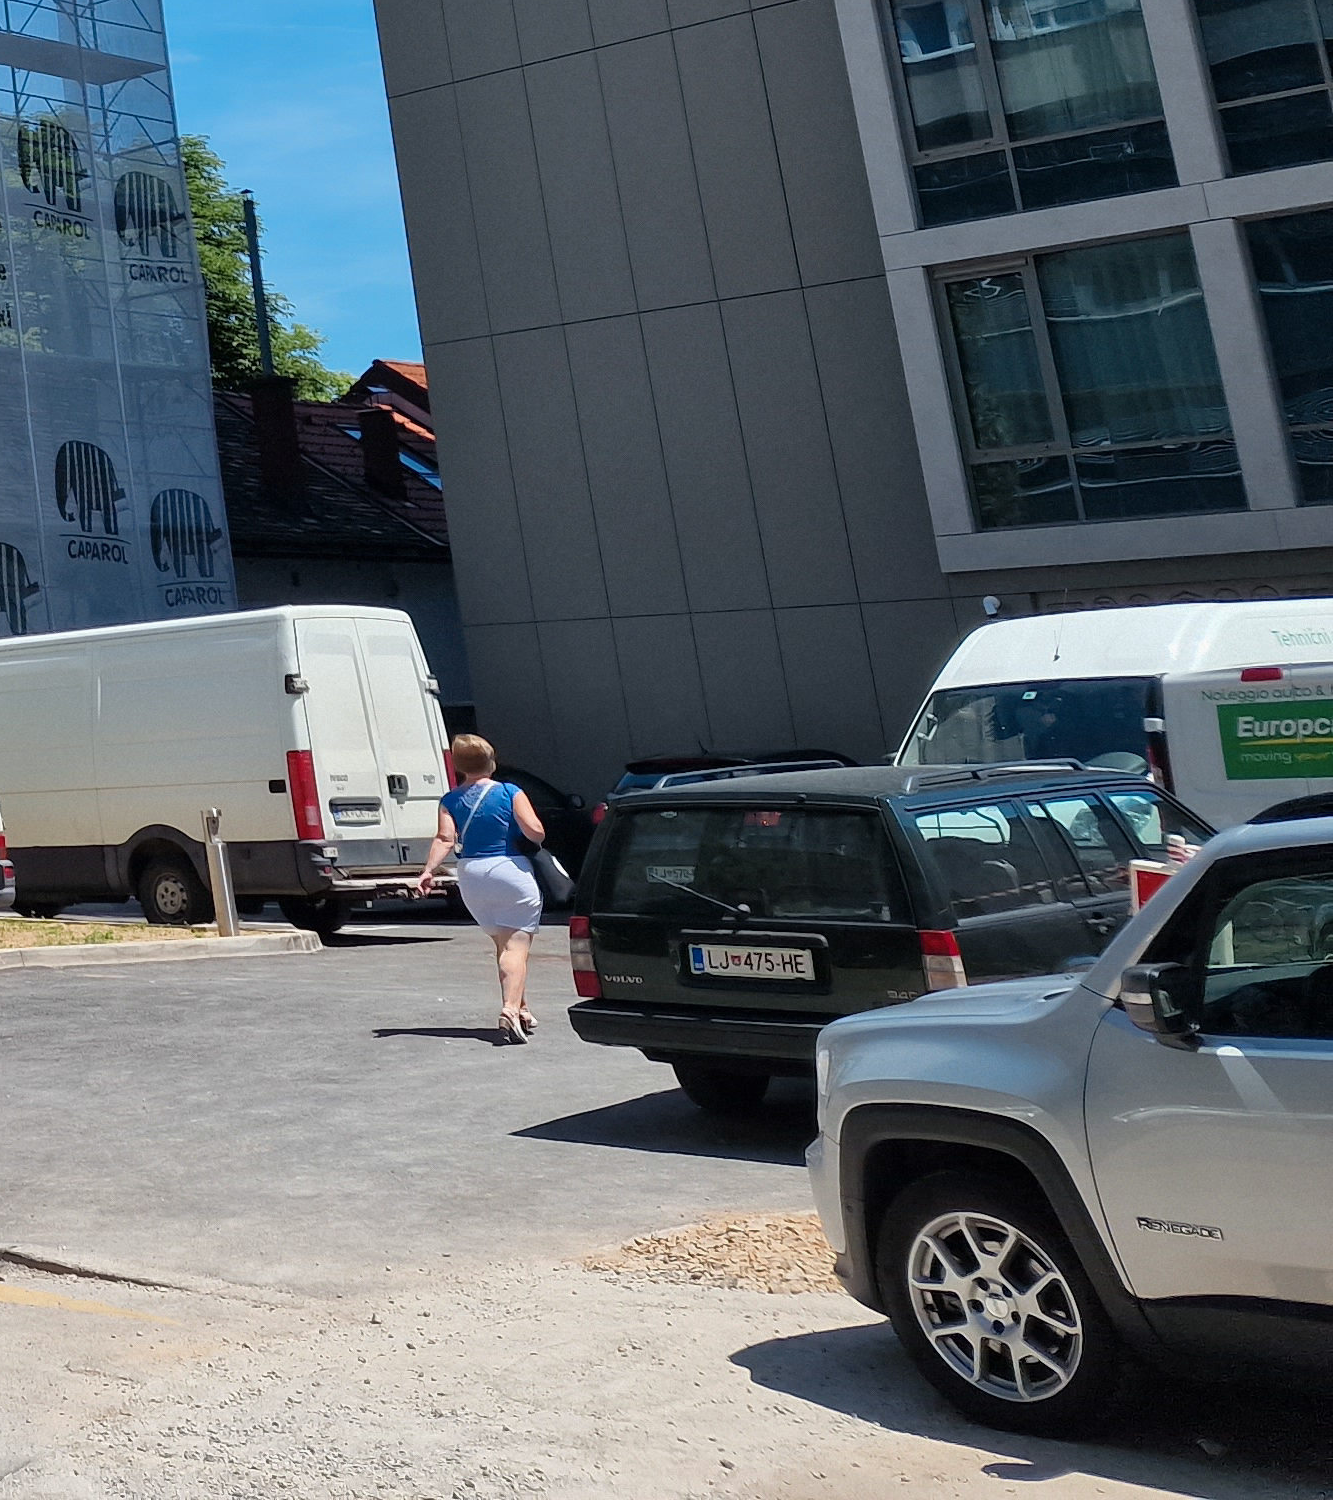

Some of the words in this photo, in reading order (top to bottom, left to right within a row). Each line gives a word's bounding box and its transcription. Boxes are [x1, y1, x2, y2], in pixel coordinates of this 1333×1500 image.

[33, 209, 91, 240] CAPAROL
[128, 263, 190, 284] CAPAROL
[67, 539, 130, 565] CAPAROL
[165, 582, 225, 607] CAPAROL
[1201, 688, 1269, 703] Noleggio
[1240, 751, 1293, 765] moving
[707, 948, 730, 970] LJ
[743, 951, 806, 975] 475-HE
[603, 974, 644, 985] VOLVO
[1136, 1216, 1224, 1242] RENEGADE
